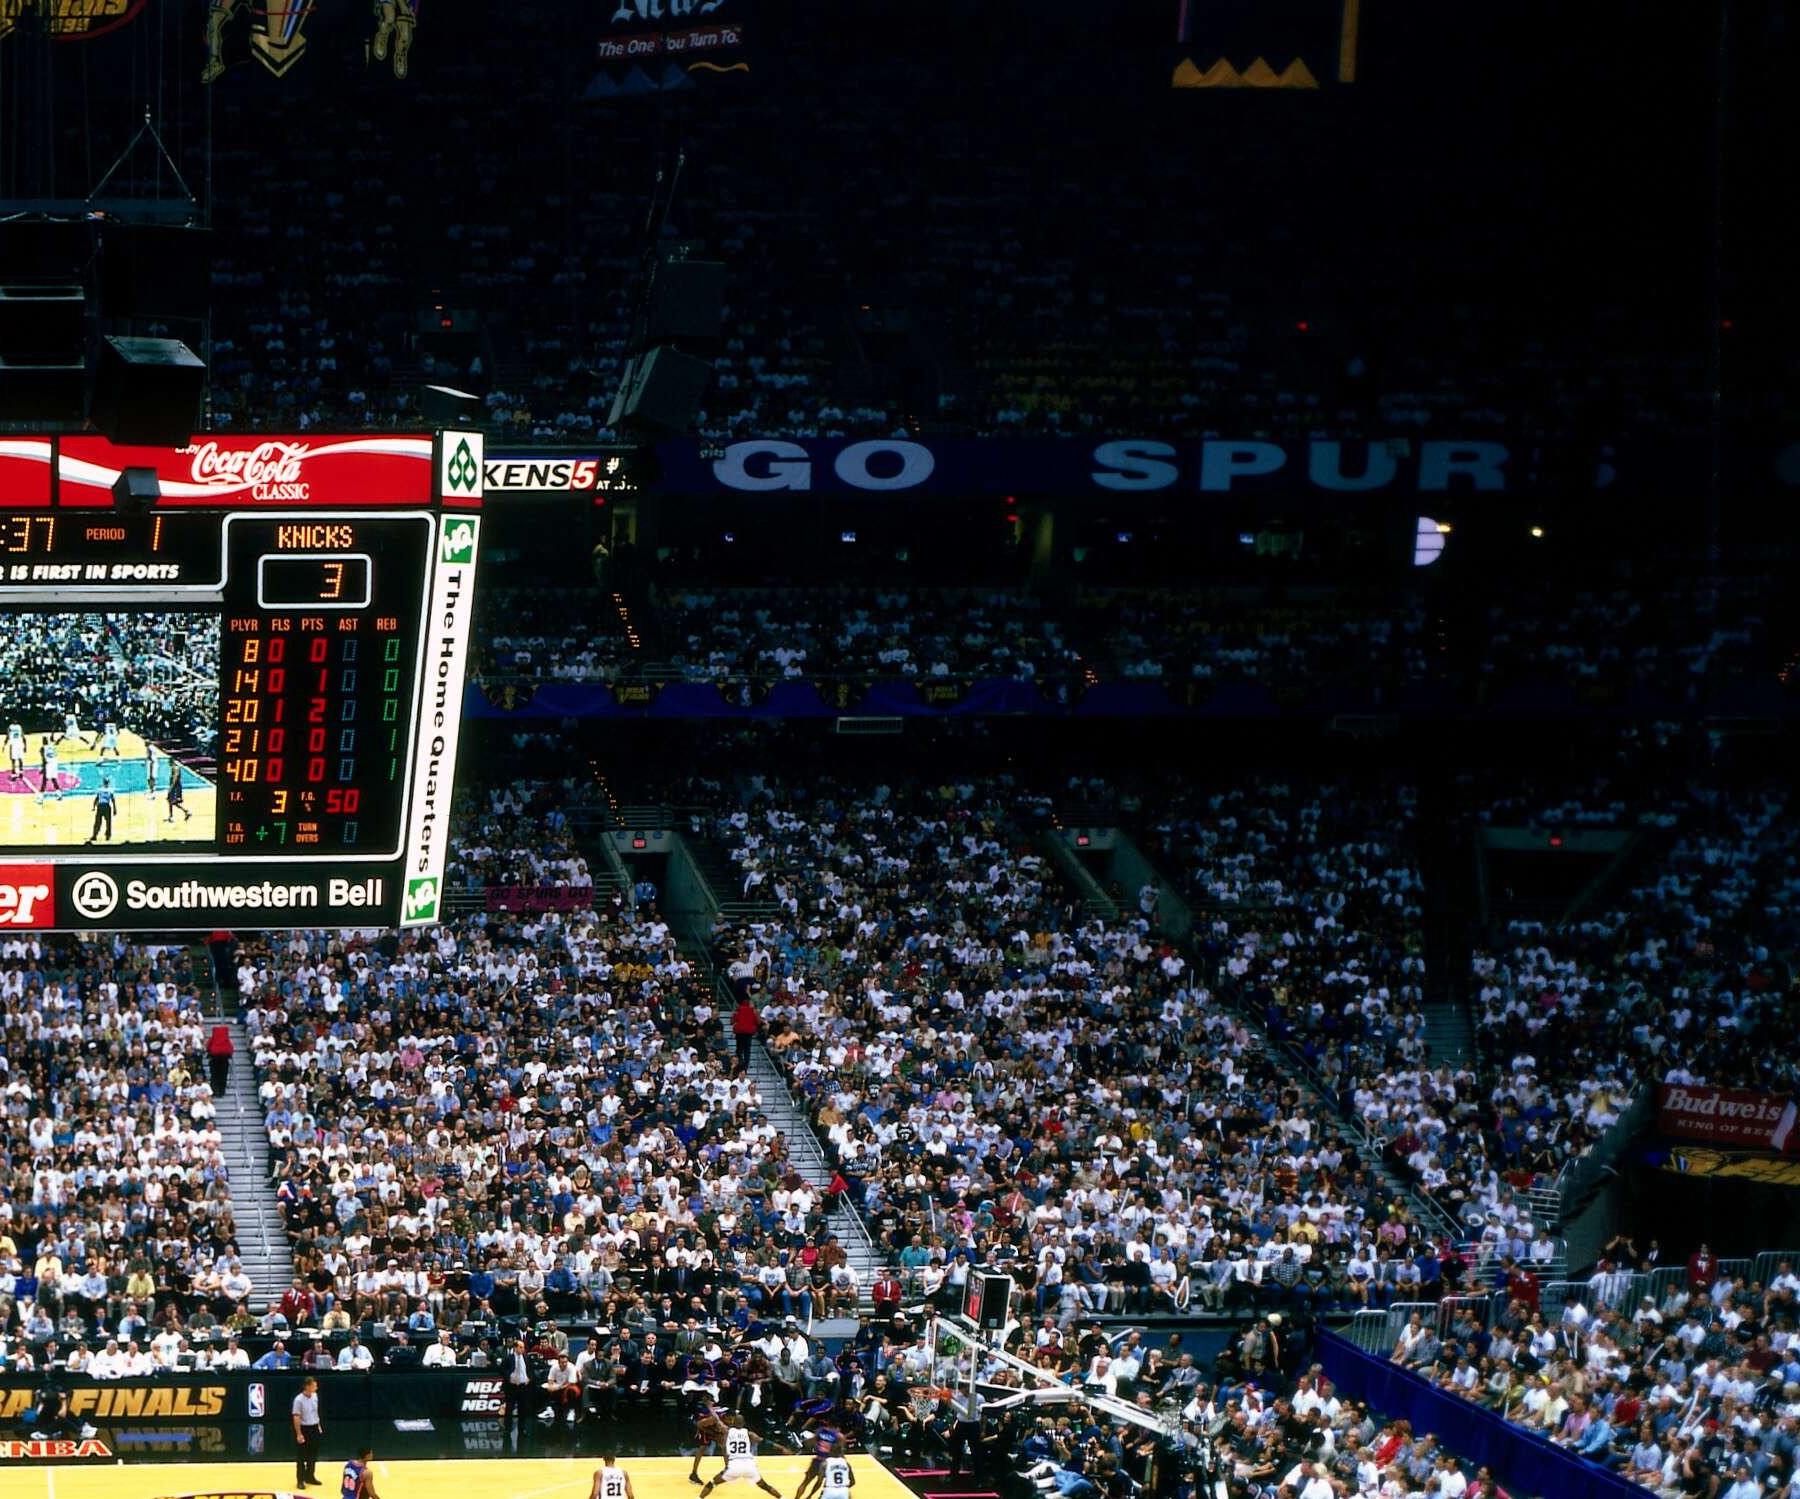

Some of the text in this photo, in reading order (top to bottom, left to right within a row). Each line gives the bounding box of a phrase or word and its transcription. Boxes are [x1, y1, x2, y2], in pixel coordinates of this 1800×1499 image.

[600, 41, 623, 57] The
[627, 39, 655, 54] One
[191, 442, 309, 486] Coca-Cola
[484, 464, 571, 487] KENS
[572, 461, 596, 489] 5
[712, 439, 936, 492] GO
[253, 484, 309, 500] CLASSIC
[86, 528, 125, 541] PERIOD
[153, 516, 161, 551] 1
[279, 526, 353, 549] KNICKS
[10, 565, 28, 580] IS
[32, 565, 82, 580] FIRST
[85, 565, 108, 580] IN
[110, 564, 179, 580] SPORTS
[320, 563, 344, 598] 3
[231, 618, 397, 632] PLYR FLS PTS AST REB
[243, 639, 259, 663] 8
[267, 638, 285, 663] 0
[311, 638, 328, 663] 0
[384, 639, 400, 661] 0
[235, 670, 259, 693] 14
[267, 668, 285, 693] 0
[319, 668, 327, 693] 1
[384, 669, 399, 691] 0
[226, 699, 259, 723] 20
[276, 699, 283, 723] 1
[309, 698, 326, 723] 2
[383, 699, 398, 721] 0
[419, 570, 462, 872] The Home Quarters
[226, 729, 258, 752] 21
[267, 728, 284, 752] 0
[309, 728, 326, 752] 0
[390, 729, 397, 751] 1
[226, 759, 258, 782] 40
[266, 758, 283, 782] 0
[308, 758, 325, 782] 0
[390, 758, 396, 781] 1
[271, 790, 288, 814] 3
[326, 789, 360, 814] 50
[226, 834, 244, 843] LEFT
[296, 834, 319, 843] OVERS
[299, 823, 317, 832] TURN
[126, 878, 382, 909] Southwestern Bell
[491, 887, 510, 899] GO
[517, 887, 561, 899] SPURS
[1677, 1120, 1739, 1134] KING OF
[69, 1387, 227, 1418] FINALS
[461, 1399, 500, 1412] NBC
[11, 1440, 112, 1458] NBA
[729, 1441, 747, 1454] 32
[606, 1482, 623, 1496] 21
[833, 1472, 844, 1485] 6
